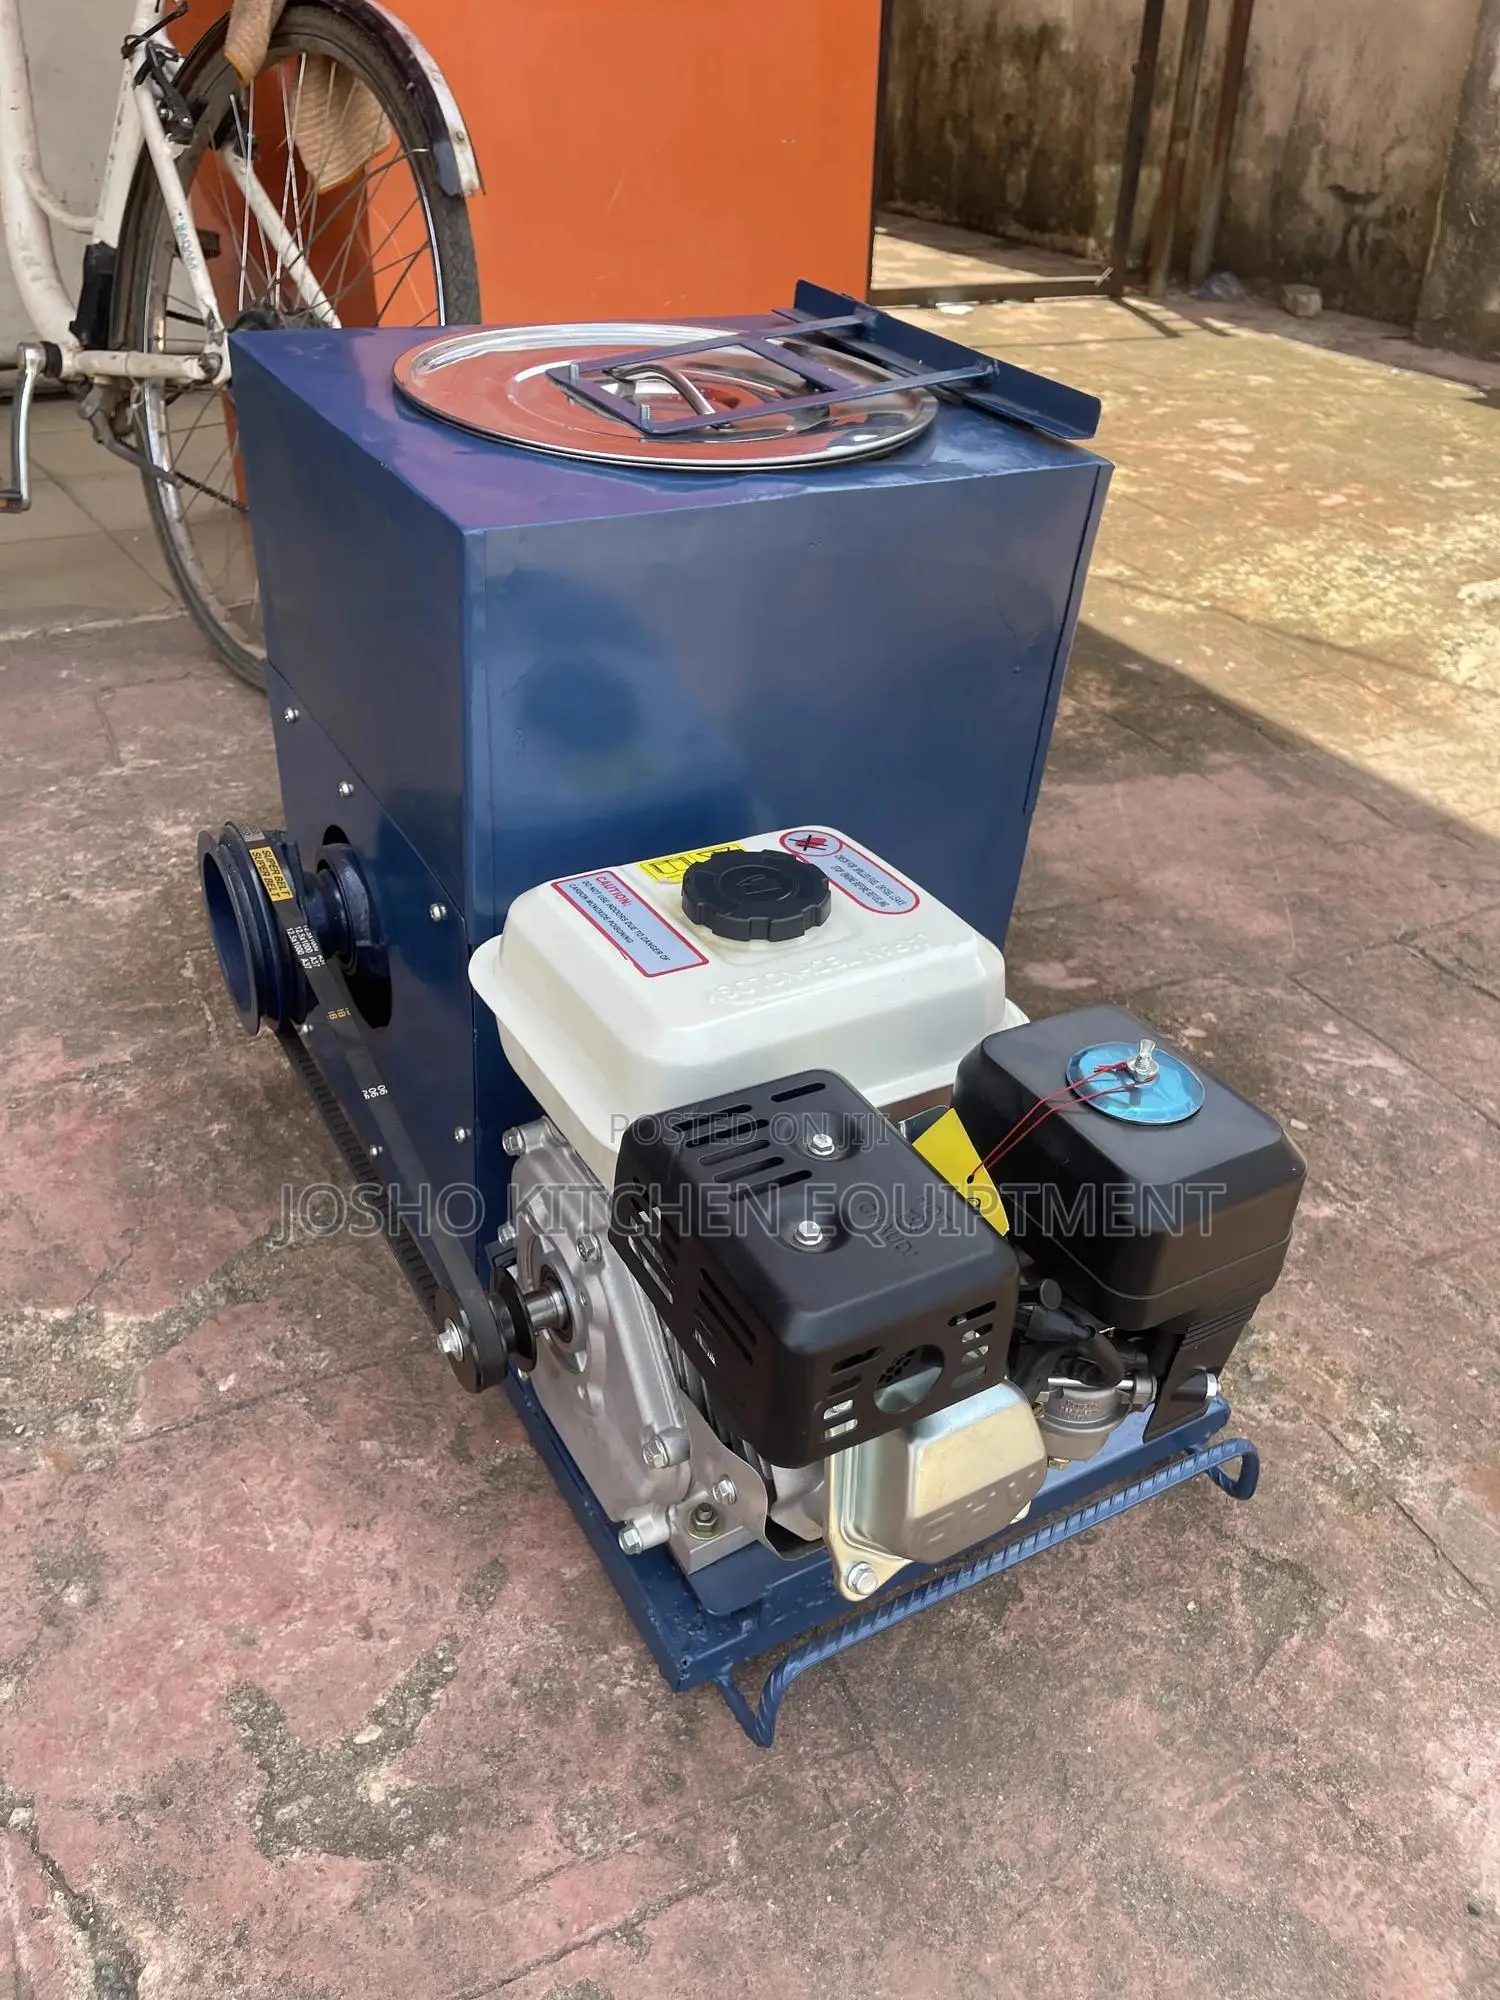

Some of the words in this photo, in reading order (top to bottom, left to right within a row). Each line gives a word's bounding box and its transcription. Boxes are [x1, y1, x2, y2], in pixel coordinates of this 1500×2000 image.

[251, 852, 271, 877] SUPER
[263, 878, 281, 898] BELT
[262, 850, 281, 875] SUPER
[274, 876, 291, 896] BELT
[596, 876, 632, 907] CAUTION:
[568, 883, 589, 900] CARBON
[586, 899, 611, 921] MONOXIDE
[608, 919, 634, 943] POISONING
[589, 886, 603, 896] NOT
[597, 894, 610, 904] USE
[606, 903, 629, 921] INDOORS
[624, 920, 639, 931] DUE
[635, 930, 645, 938] TO
[640, 936, 664, 956] DANGER
[660, 953, 671, 961] OF
